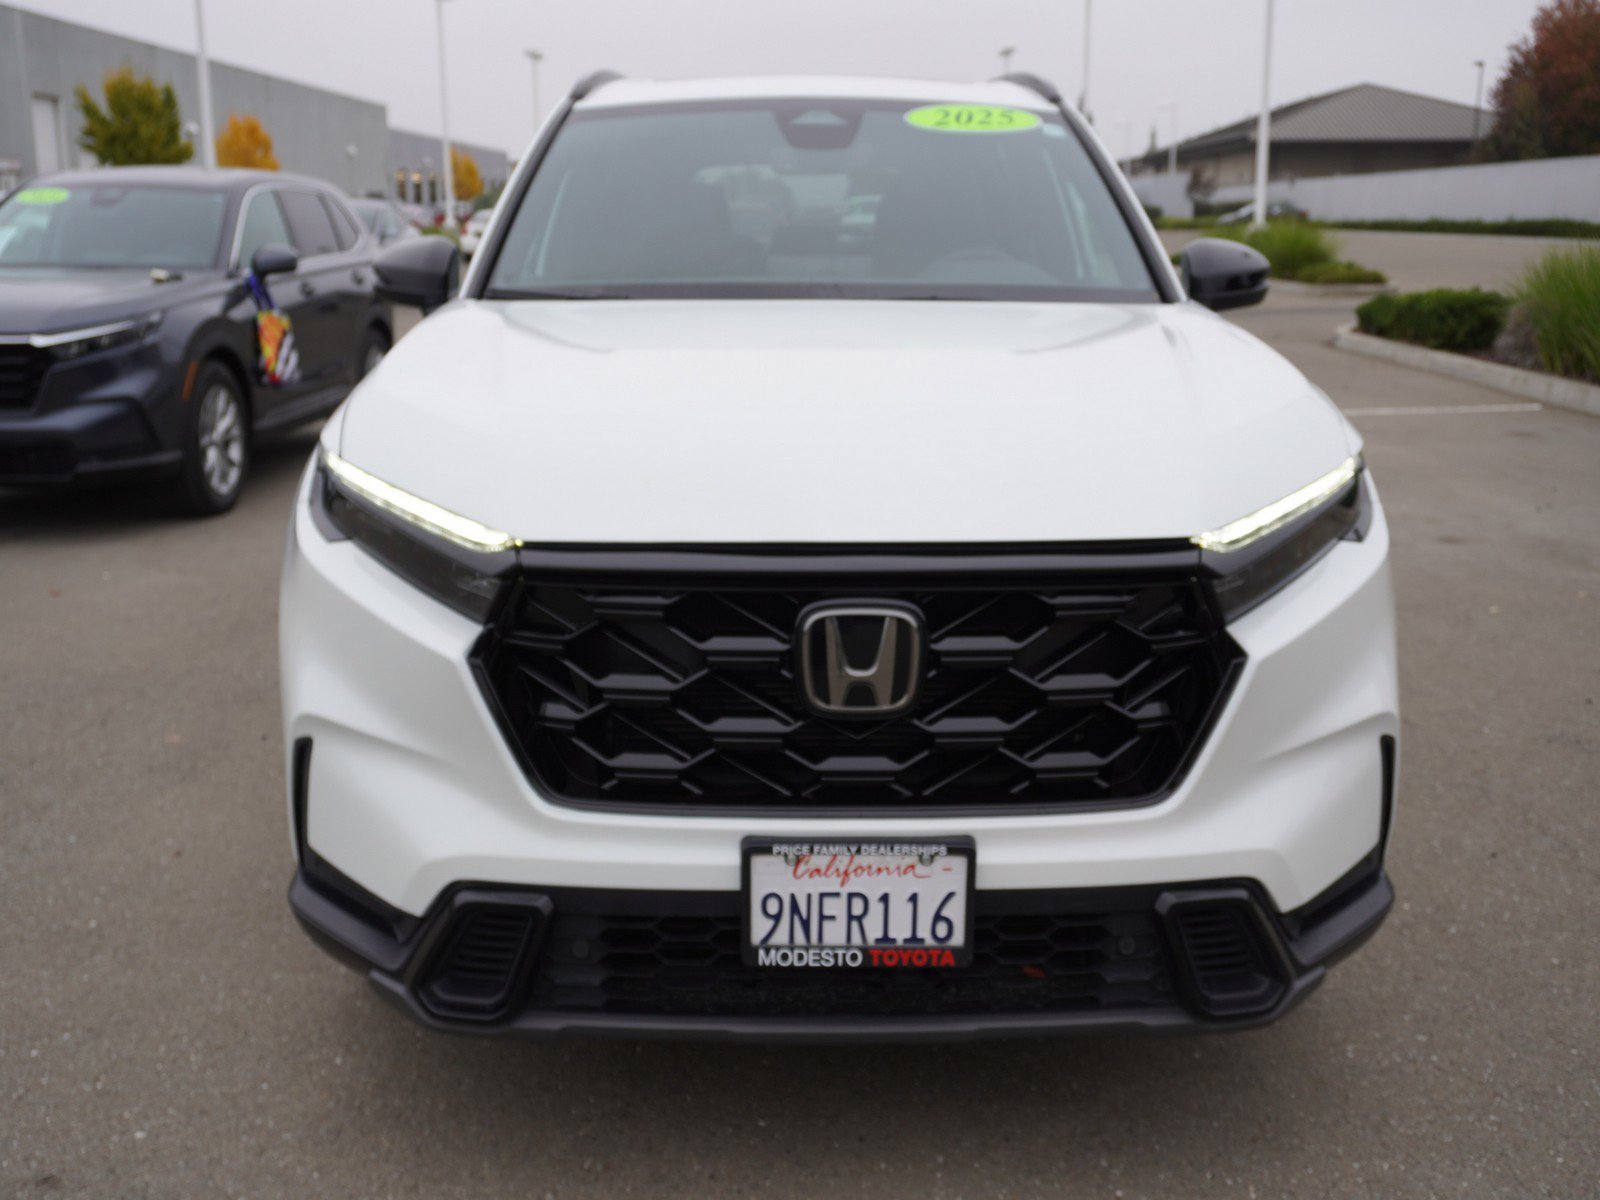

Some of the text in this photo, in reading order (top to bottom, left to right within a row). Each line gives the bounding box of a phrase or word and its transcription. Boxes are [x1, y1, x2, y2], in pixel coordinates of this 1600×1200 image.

[934, 109, 1015, 126] 2025
[772, 844, 948, 857] PRICE FAMILY DEALERSHIPS
[792, 854, 931, 887] California
[759, 892, 956, 945] 9NFR116
[758, 948, 956, 967] MODESTO TOYOTA
